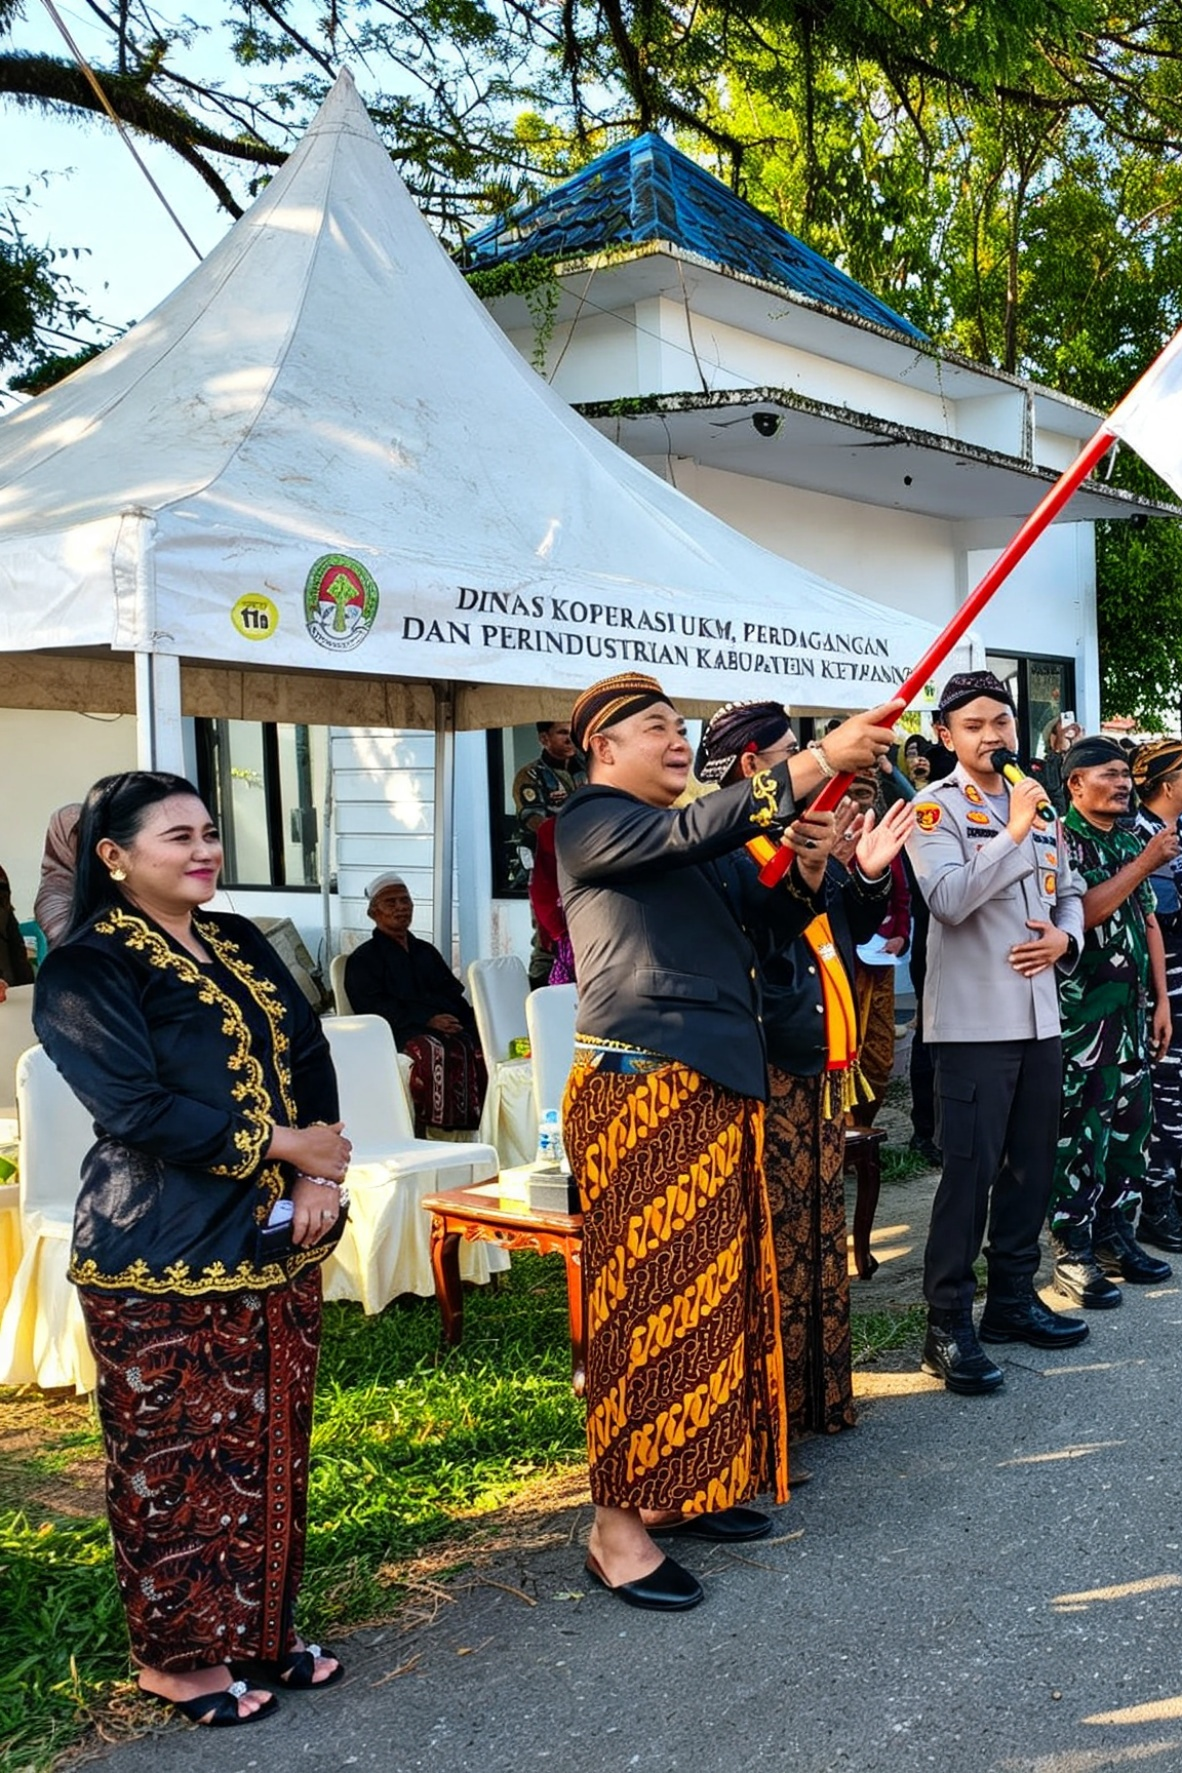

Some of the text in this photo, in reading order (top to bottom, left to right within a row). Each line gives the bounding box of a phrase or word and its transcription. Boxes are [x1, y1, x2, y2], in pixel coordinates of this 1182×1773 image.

[402, 616, 471, 646] DAN
[482, 624, 689, 667] PERINDUSTRIAN
[456, 586, 889, 657] DINAS KOPERASI UKM, PERDAGANGAN
